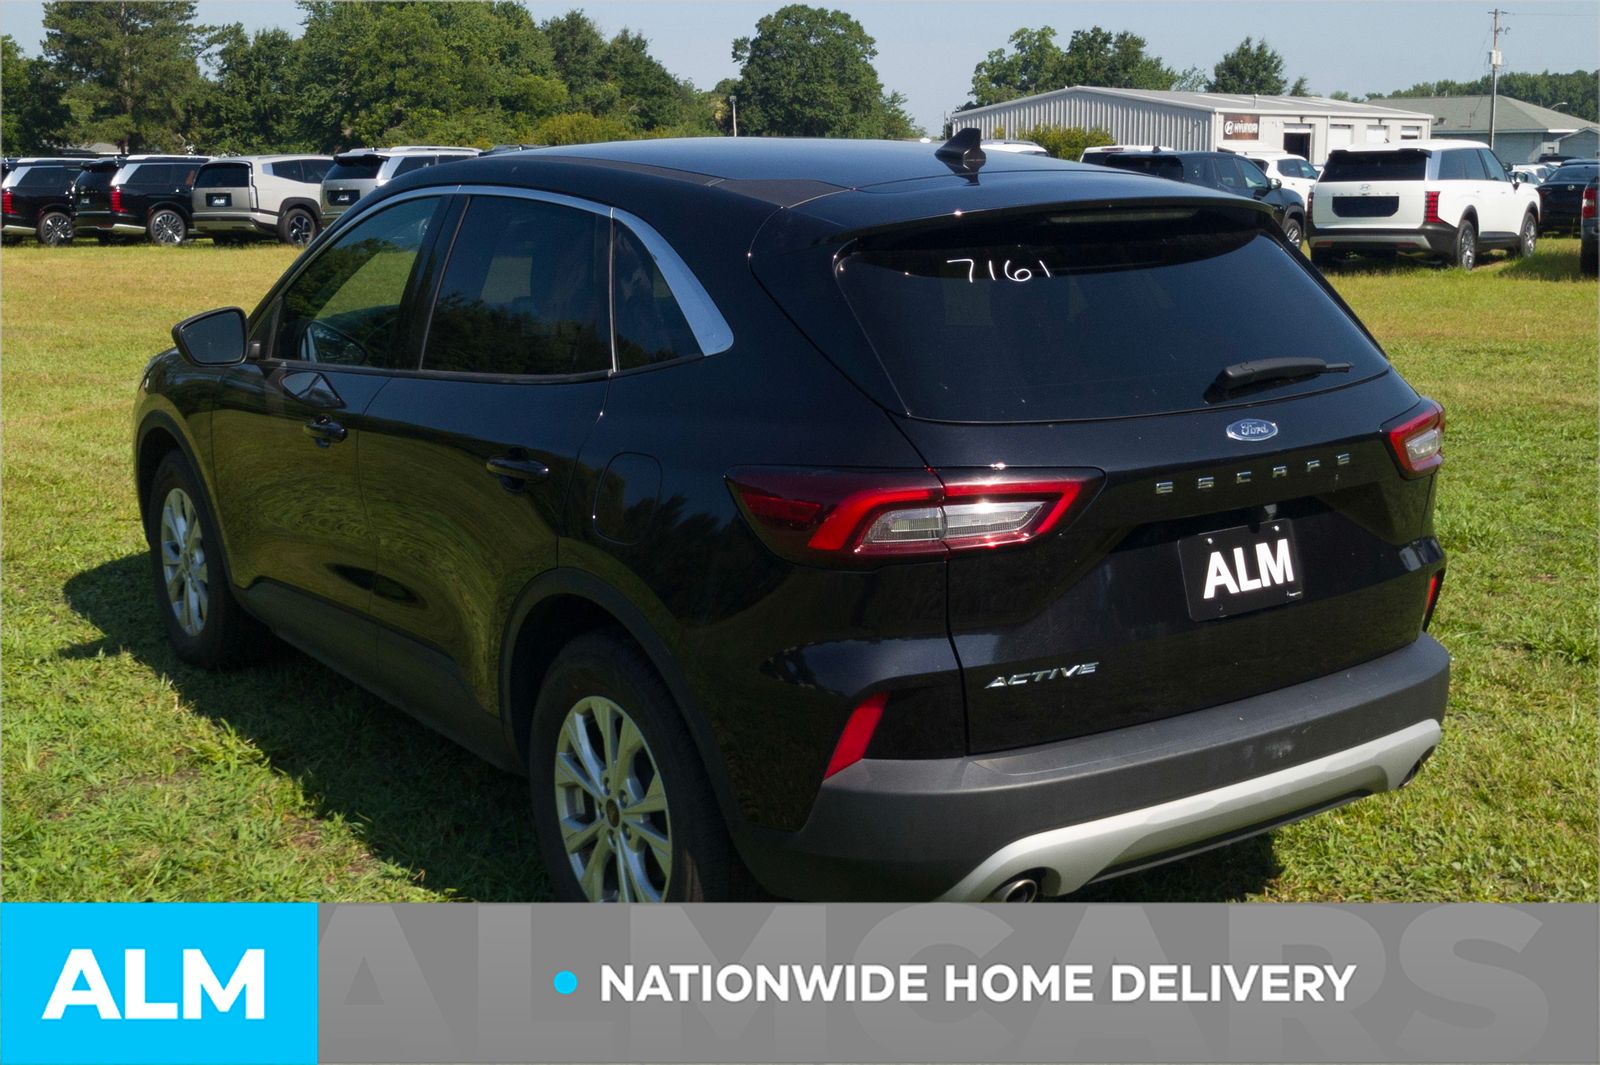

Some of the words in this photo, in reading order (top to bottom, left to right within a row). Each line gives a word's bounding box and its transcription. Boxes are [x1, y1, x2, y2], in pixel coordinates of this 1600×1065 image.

[946, 258, 1052, 284] 7161
[1240, 421, 1270, 436] Ford
[1155, 453, 1350, 495] ESCAPE
[1203, 538, 1295, 600] ALM
[984, 661, 1100, 689] ACTIVE
